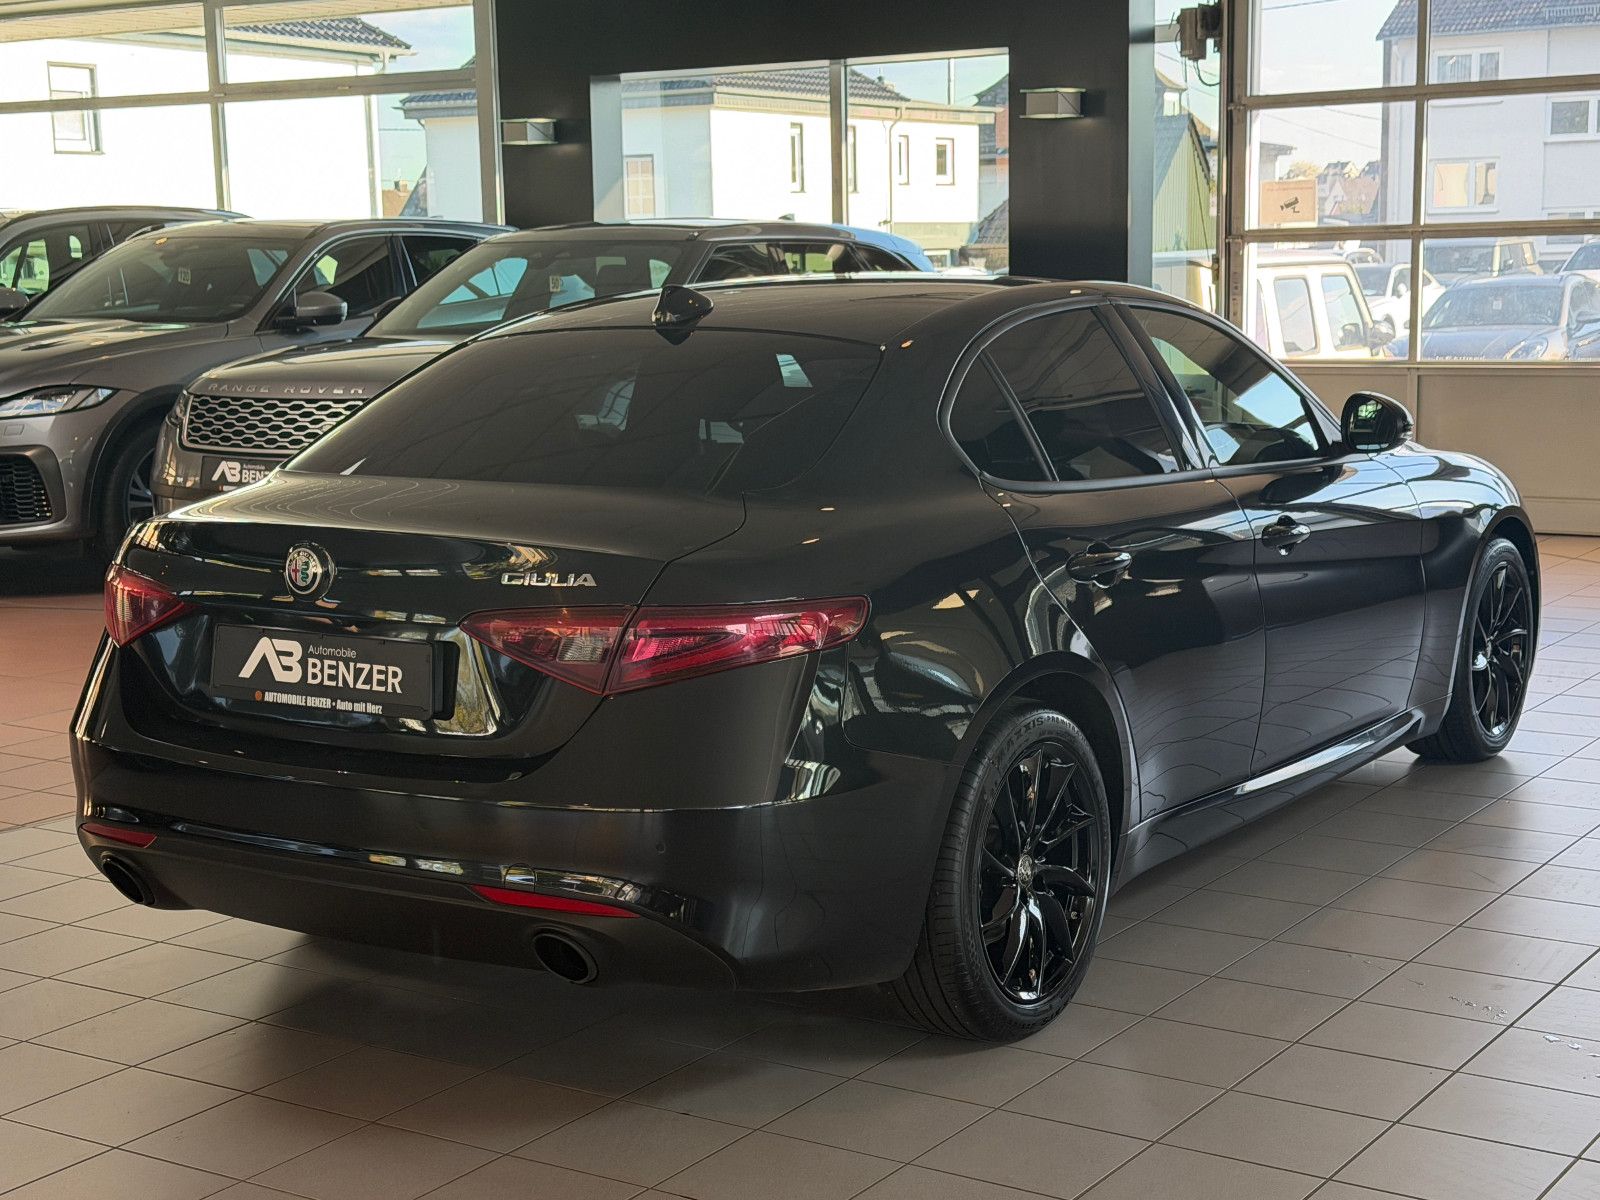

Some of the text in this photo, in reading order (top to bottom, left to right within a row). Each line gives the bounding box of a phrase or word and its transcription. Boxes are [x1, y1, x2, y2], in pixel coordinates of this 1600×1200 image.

[208, 383, 364, 394] RANGE ROVER
[501, 572, 597, 587] GIULIA
[307, 644, 357, 659] Automobile
[306, 657, 403, 694] BENZER
[264, 691, 383, 715] AUTOMOBILE BENZER Auto mit Herz
